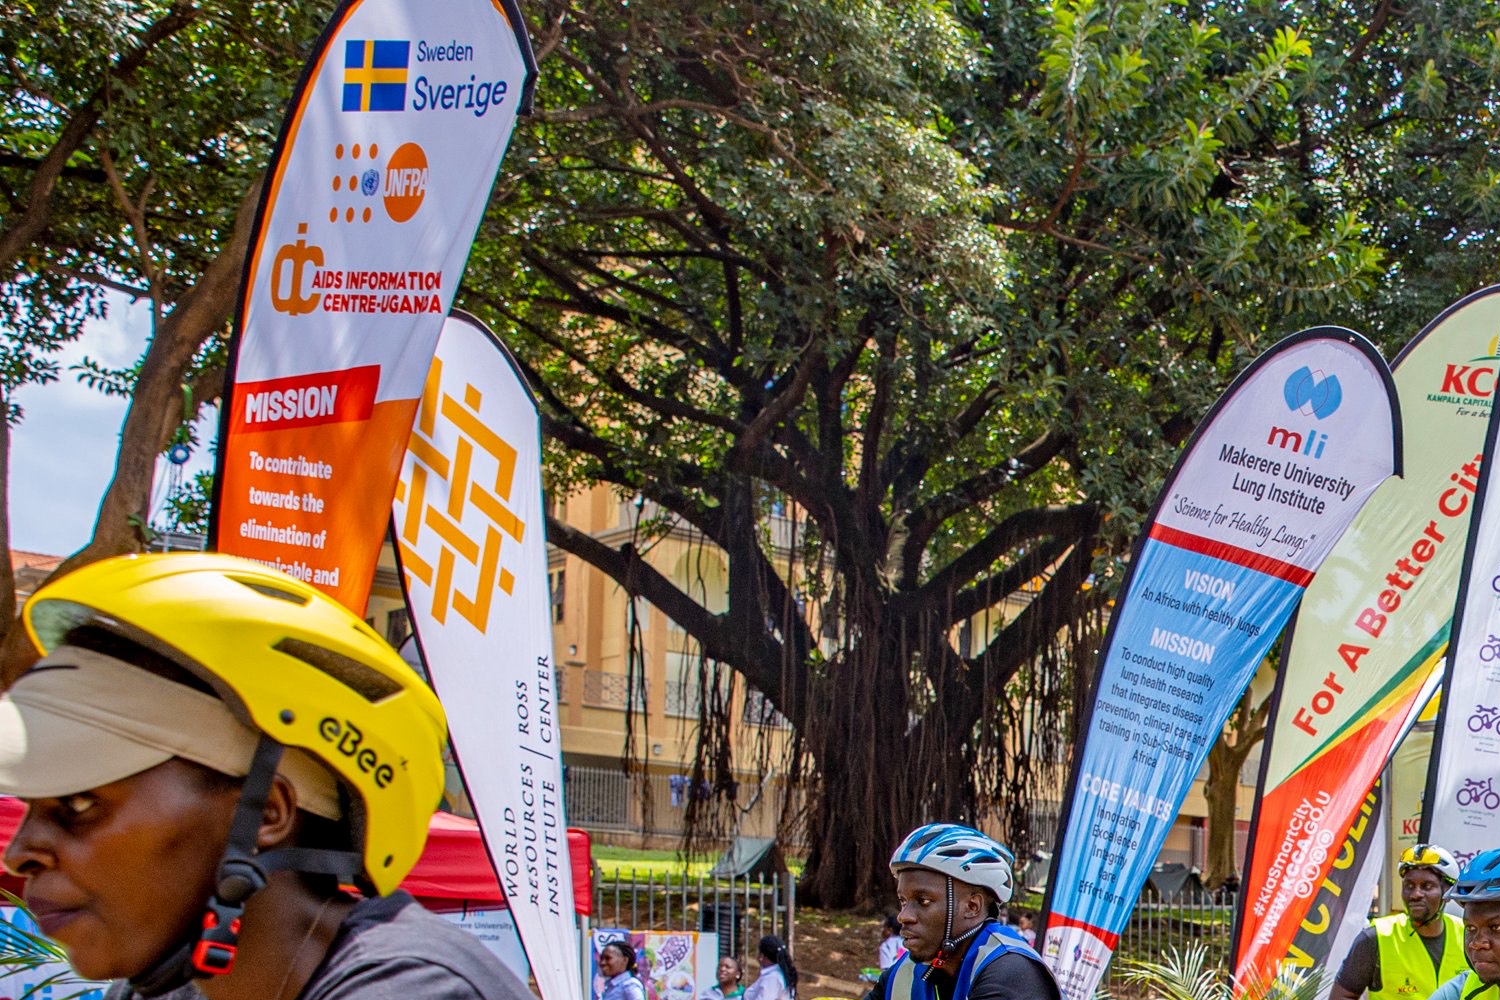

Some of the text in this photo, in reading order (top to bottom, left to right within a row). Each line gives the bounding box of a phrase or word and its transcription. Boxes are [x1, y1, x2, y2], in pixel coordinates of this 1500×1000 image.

[416, 40, 474, 62] Sweden
[412, 75, 508, 117] Sverige
[383, 168, 429, 197] UNFPA
[312, 271, 343, 289] AIDS
[323, 294, 442, 314] CENTRE-UGANDA
[245, 385, 338, 424] MISSION
[1426, 394, 1461, 405] KAMPALA
[1267, 426, 1328, 460] mli
[249, 451, 333, 480] To contribute
[1218, 443, 1356, 502] Makerere University
[248, 487, 324, 514] towards the
[1232, 472, 1326, 516] Lung Institute
[240, 519, 327, 550] elimination of
[1208, 504, 1228, 528] for
[1227, 511, 1273, 548] Healthy
[313, 565, 339, 588] and
[1184, 569, 1236, 602] VISION
[1141, 587, 1261, 638] An Africa with healthy lungs
[1292, 671, 1344, 737] For
[1336, 640, 1372, 674] A
[1355, 520, 1446, 639] Better
[1150, 627, 1216, 665] MISSION
[1120, 666, 1204, 705] lung health research
[1121, 647, 1216, 691] To conduct high quality
[1095, 699, 1142, 726] prevention,
[1143, 716, 1174, 735] clinical
[1174, 727, 1192, 742] care
[1111, 683, 1203, 725] that integrates disease
[1099, 718, 1130, 743] training
[1132, 728, 1141, 741] in
[318, 716, 395, 789] eBee
[1131, 748, 1158, 769] Africa
[517, 680, 542, 908] RESOURCES ROSS
[537, 654, 561, 918] INSTITUTE CENTER
[1080, 773, 1174, 823] CORE VALUES
[1091, 824, 1138, 851] Excellence
[1096, 805, 1142, 832] Innovation
[506, 806, 520, 899] WORLD
[474, 921, 514, 931] University
